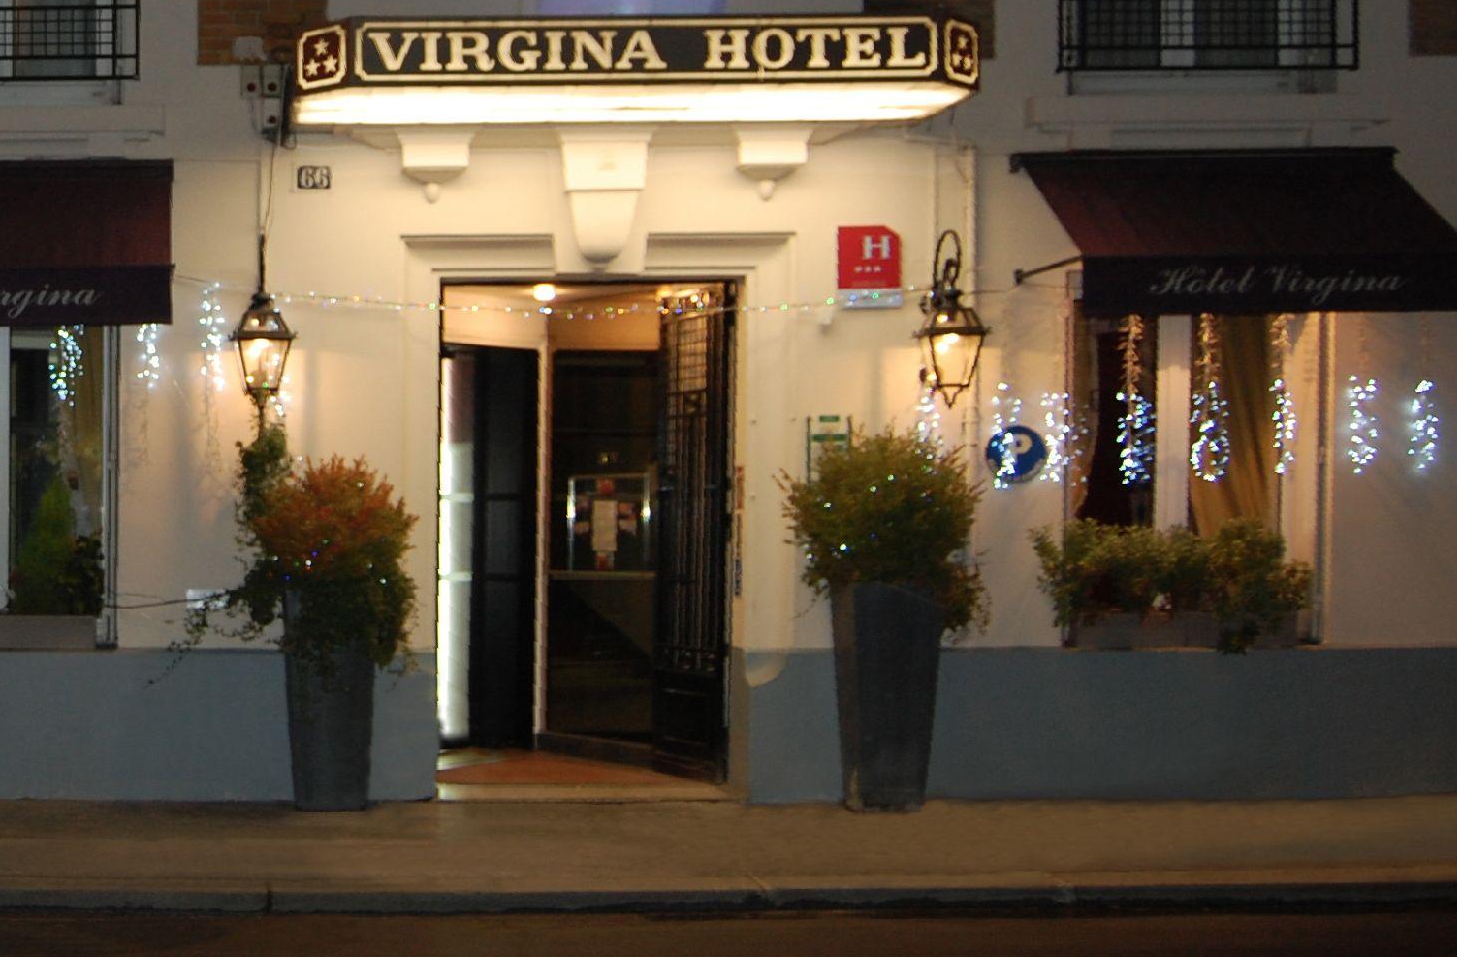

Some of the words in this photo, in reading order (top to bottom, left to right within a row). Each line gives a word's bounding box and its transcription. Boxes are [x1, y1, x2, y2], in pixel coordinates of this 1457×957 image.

[368, 30, 668, 72] VIRGINA
[703, 27, 927, 70] HOTEL
[300, 166, 330, 189] 66
[863, 234, 891, 260] H
[1150, 265, 1257, 295] Hôtel
[1262, 264, 1407, 307] Virgina
